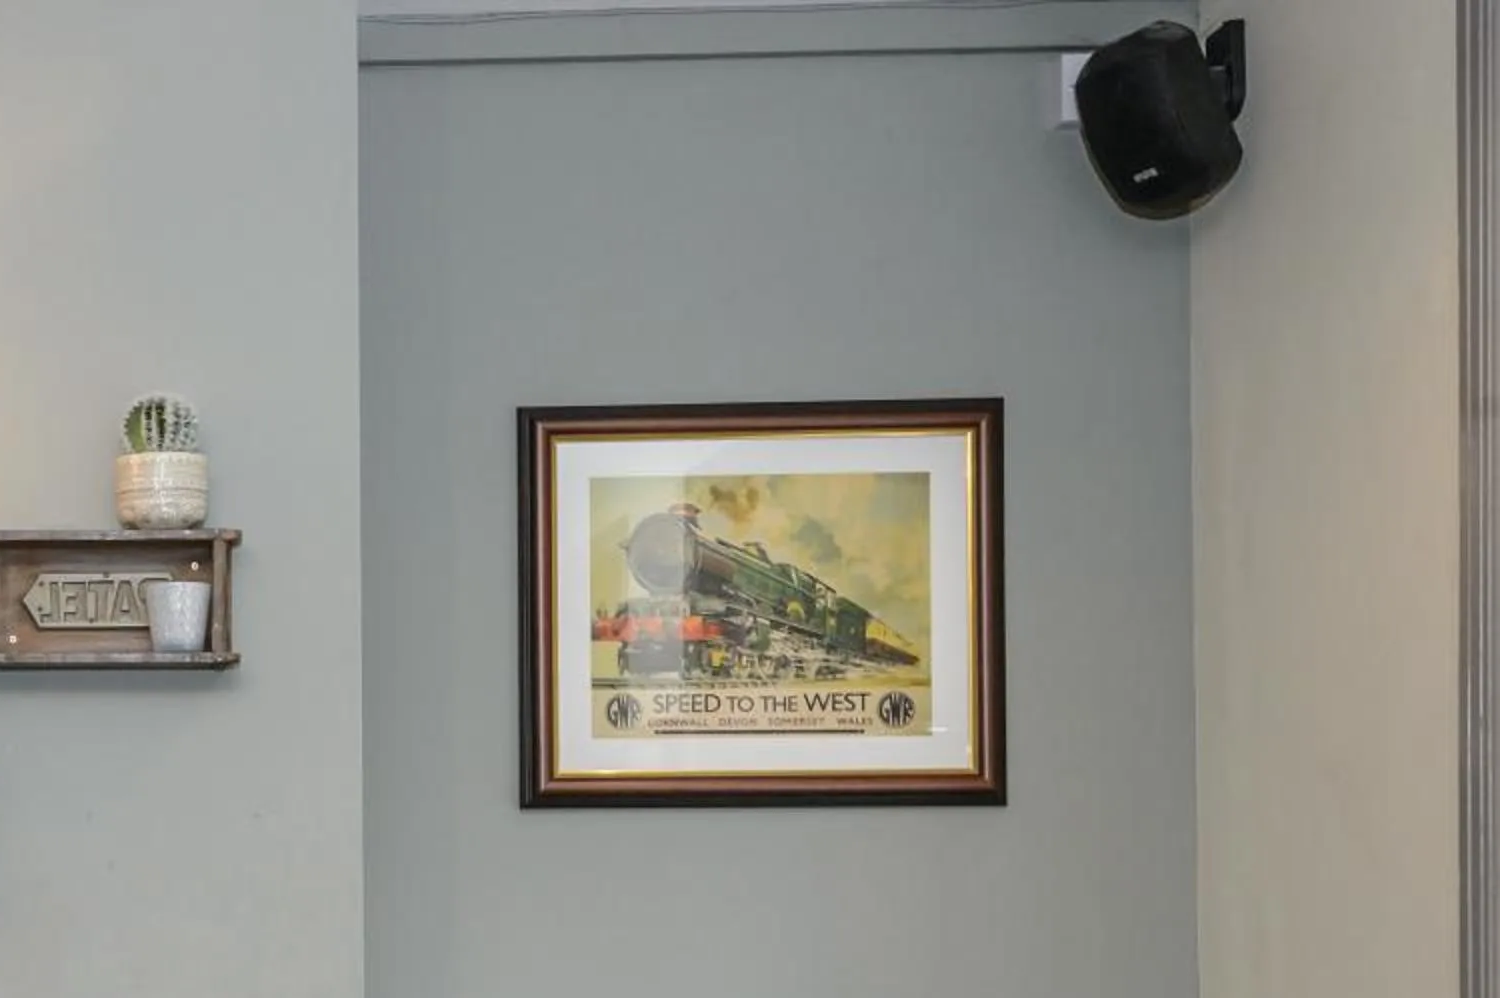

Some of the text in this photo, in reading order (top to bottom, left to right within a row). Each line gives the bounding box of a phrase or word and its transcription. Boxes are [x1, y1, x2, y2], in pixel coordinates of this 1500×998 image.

[652, 691, 872, 714] SPEED TO THE WEST
[879, 691, 916, 728] GWR
[648, 716, 874, 728] CORNWALL DEVON SOMERSET WALES
